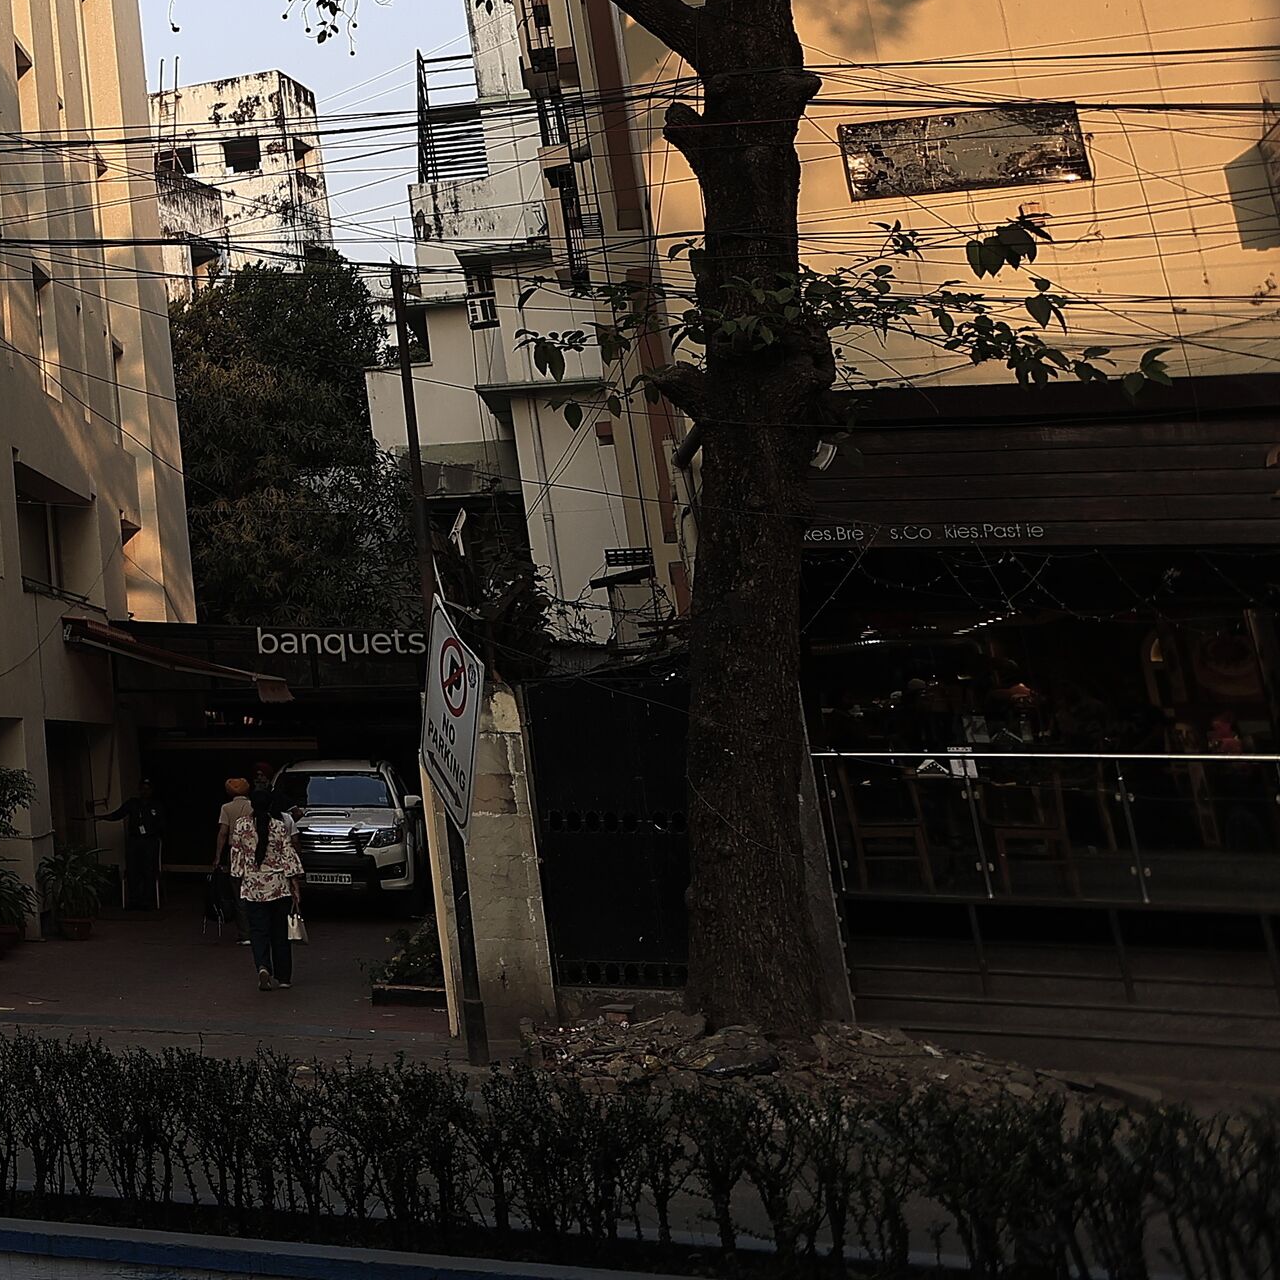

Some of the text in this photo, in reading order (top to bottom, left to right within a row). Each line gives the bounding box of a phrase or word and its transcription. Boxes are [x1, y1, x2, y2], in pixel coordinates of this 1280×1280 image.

[256, 626, 427, 662] banquets
[441, 712, 456, 746] NO
[428, 718, 466, 792] PARKING
